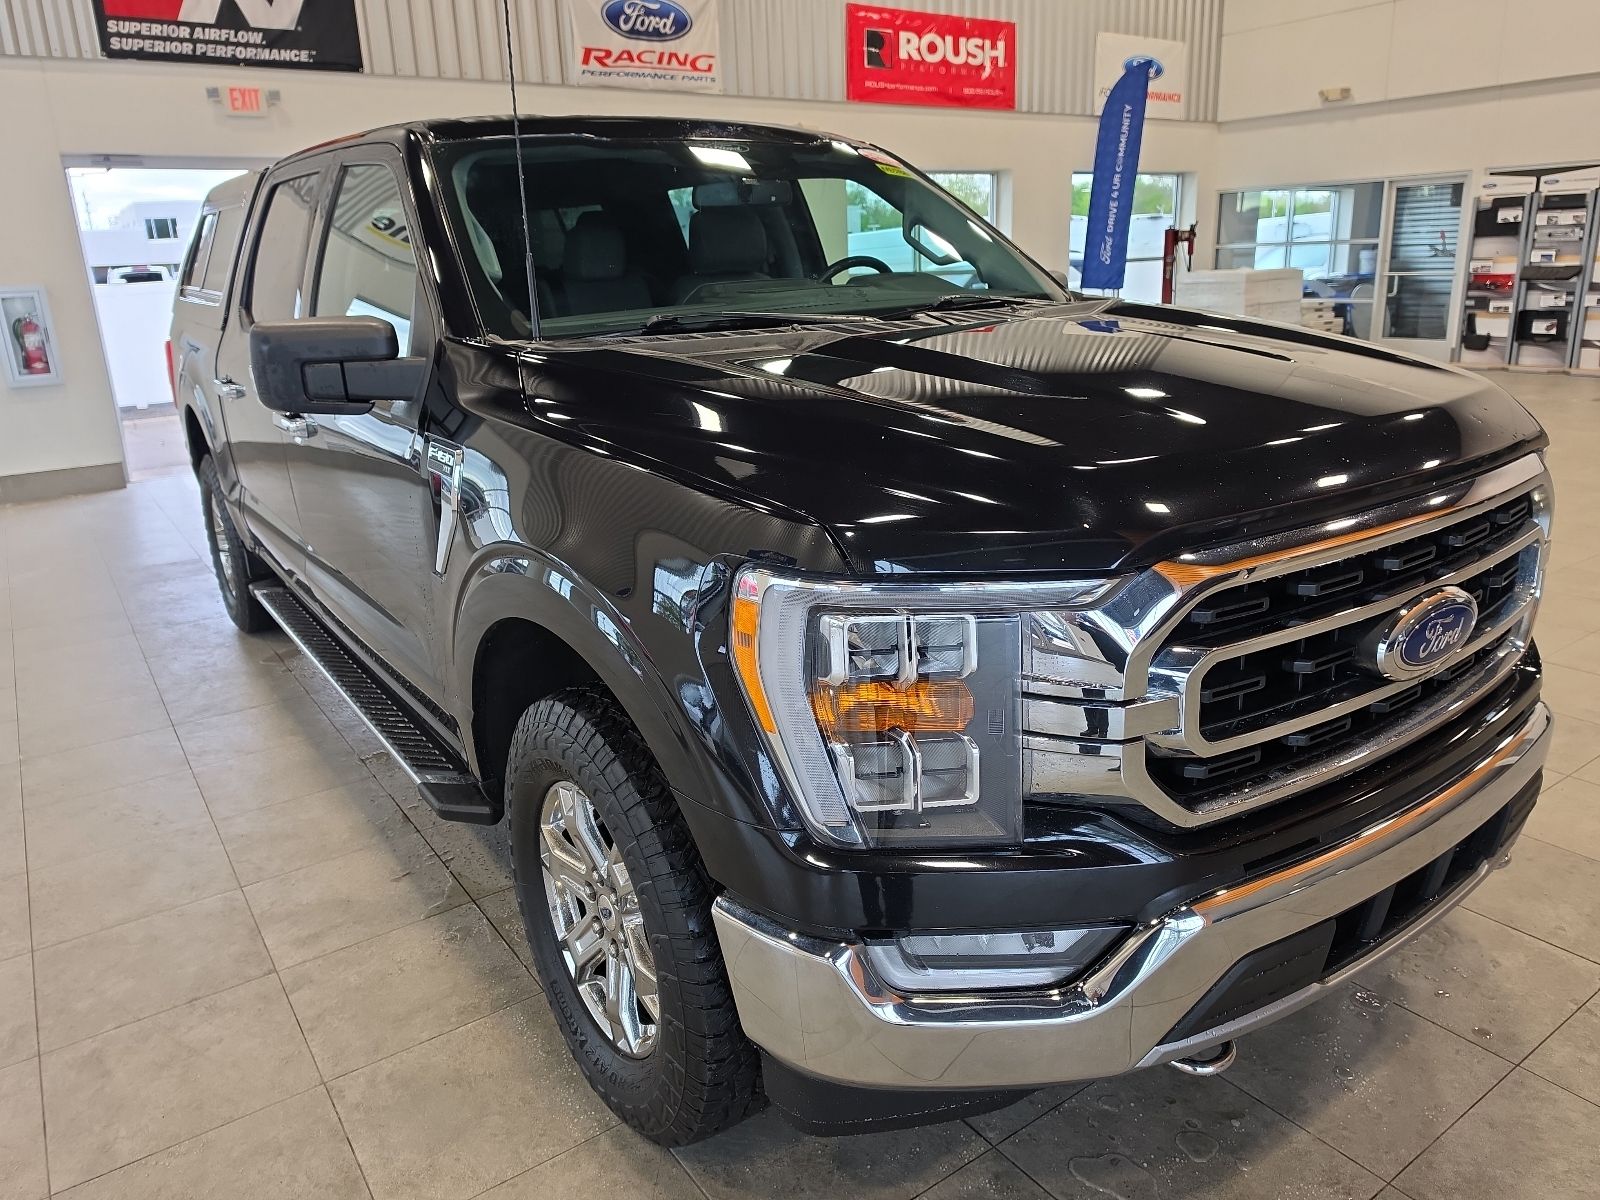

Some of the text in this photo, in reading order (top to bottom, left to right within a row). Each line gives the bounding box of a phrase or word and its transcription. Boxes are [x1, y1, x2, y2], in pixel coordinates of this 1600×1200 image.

[618, 0, 676, 35] Ford
[106, 19, 267, 45] SUPERIOR AIRFLOW.
[109, 36, 193, 56] SUPERIOR
[581, 47, 715, 73] RACING
[898, 30, 1006, 80] ROUSH
[581, 69, 716, 83] PERFORMANCE PARTS
[228, 86, 260, 112] EXIT
[1115, 104, 1133, 173] COMMUNITY
[1110, 190, 1120, 199] 4
[1106, 200, 1119, 233] DRIVE
[1100, 234, 1113, 265] Ford
[1419, 613, 1465, 659] Ford
